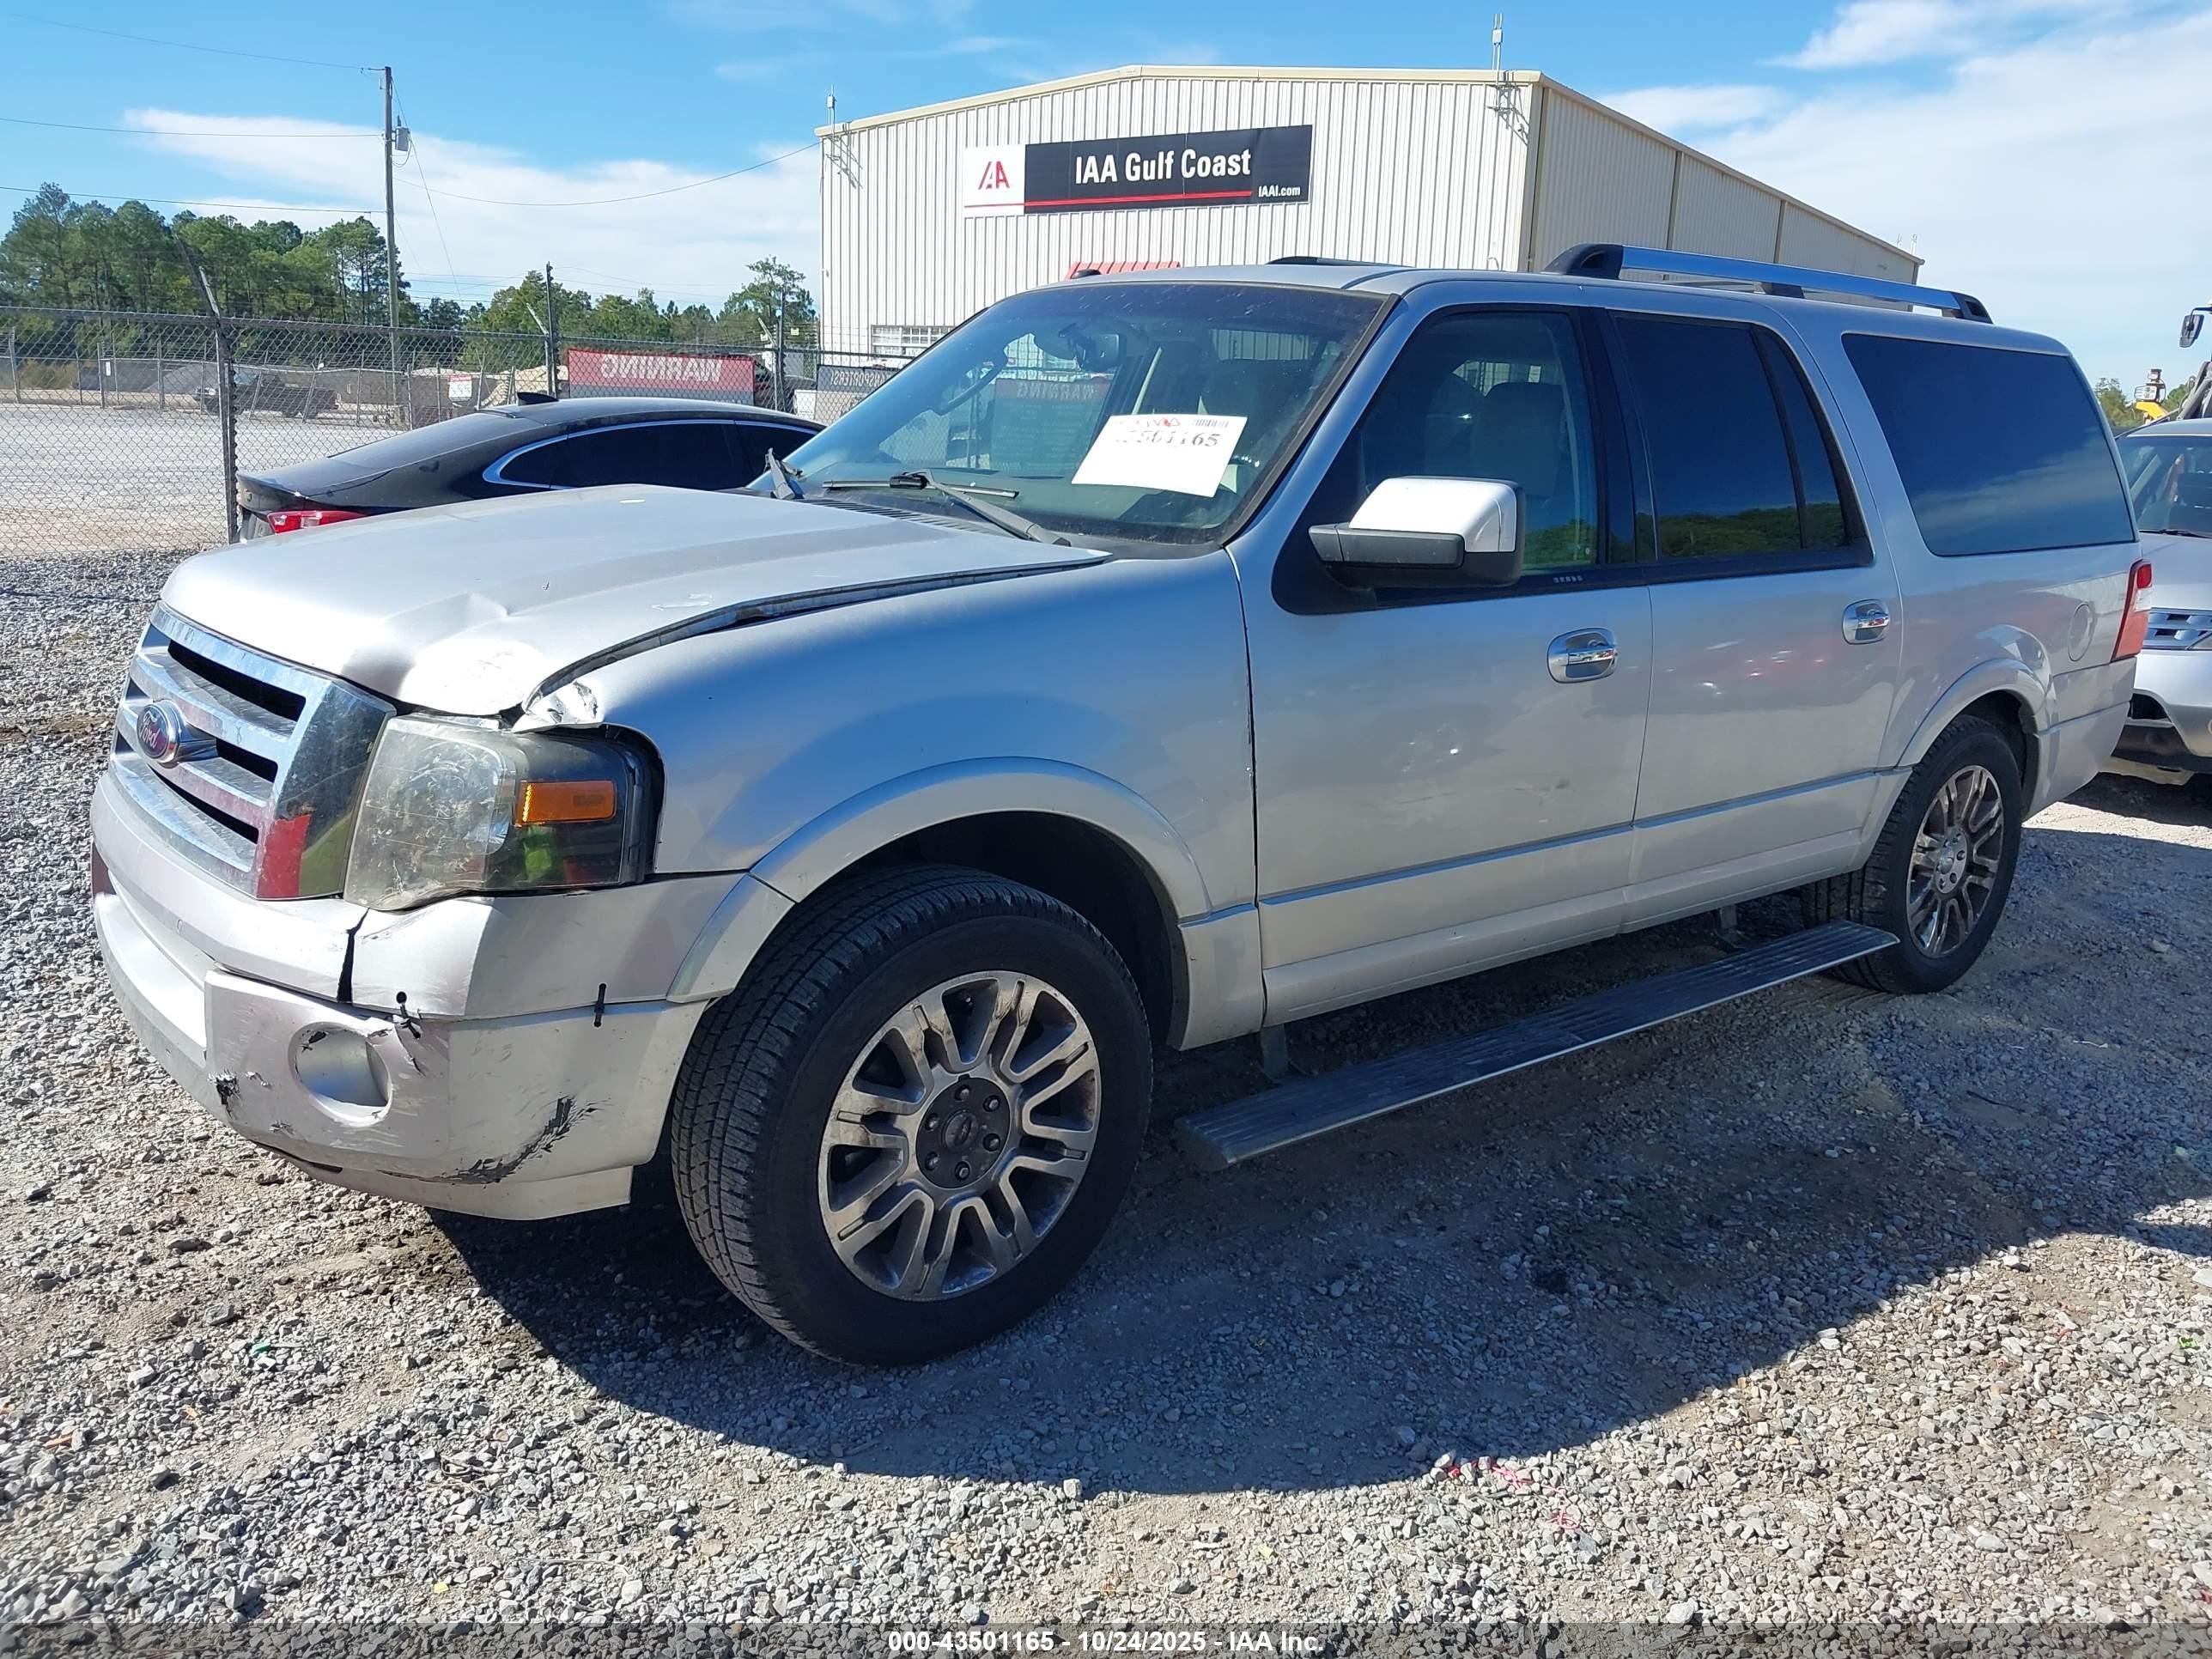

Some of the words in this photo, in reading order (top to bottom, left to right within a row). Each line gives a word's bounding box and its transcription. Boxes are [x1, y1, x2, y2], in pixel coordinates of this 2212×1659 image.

[1075, 155, 1117, 184] IAA
[1126, 151, 1174, 182] Gulf
[1182, 148, 1251, 179] Coast
[140, 711, 161, 749] Ford
